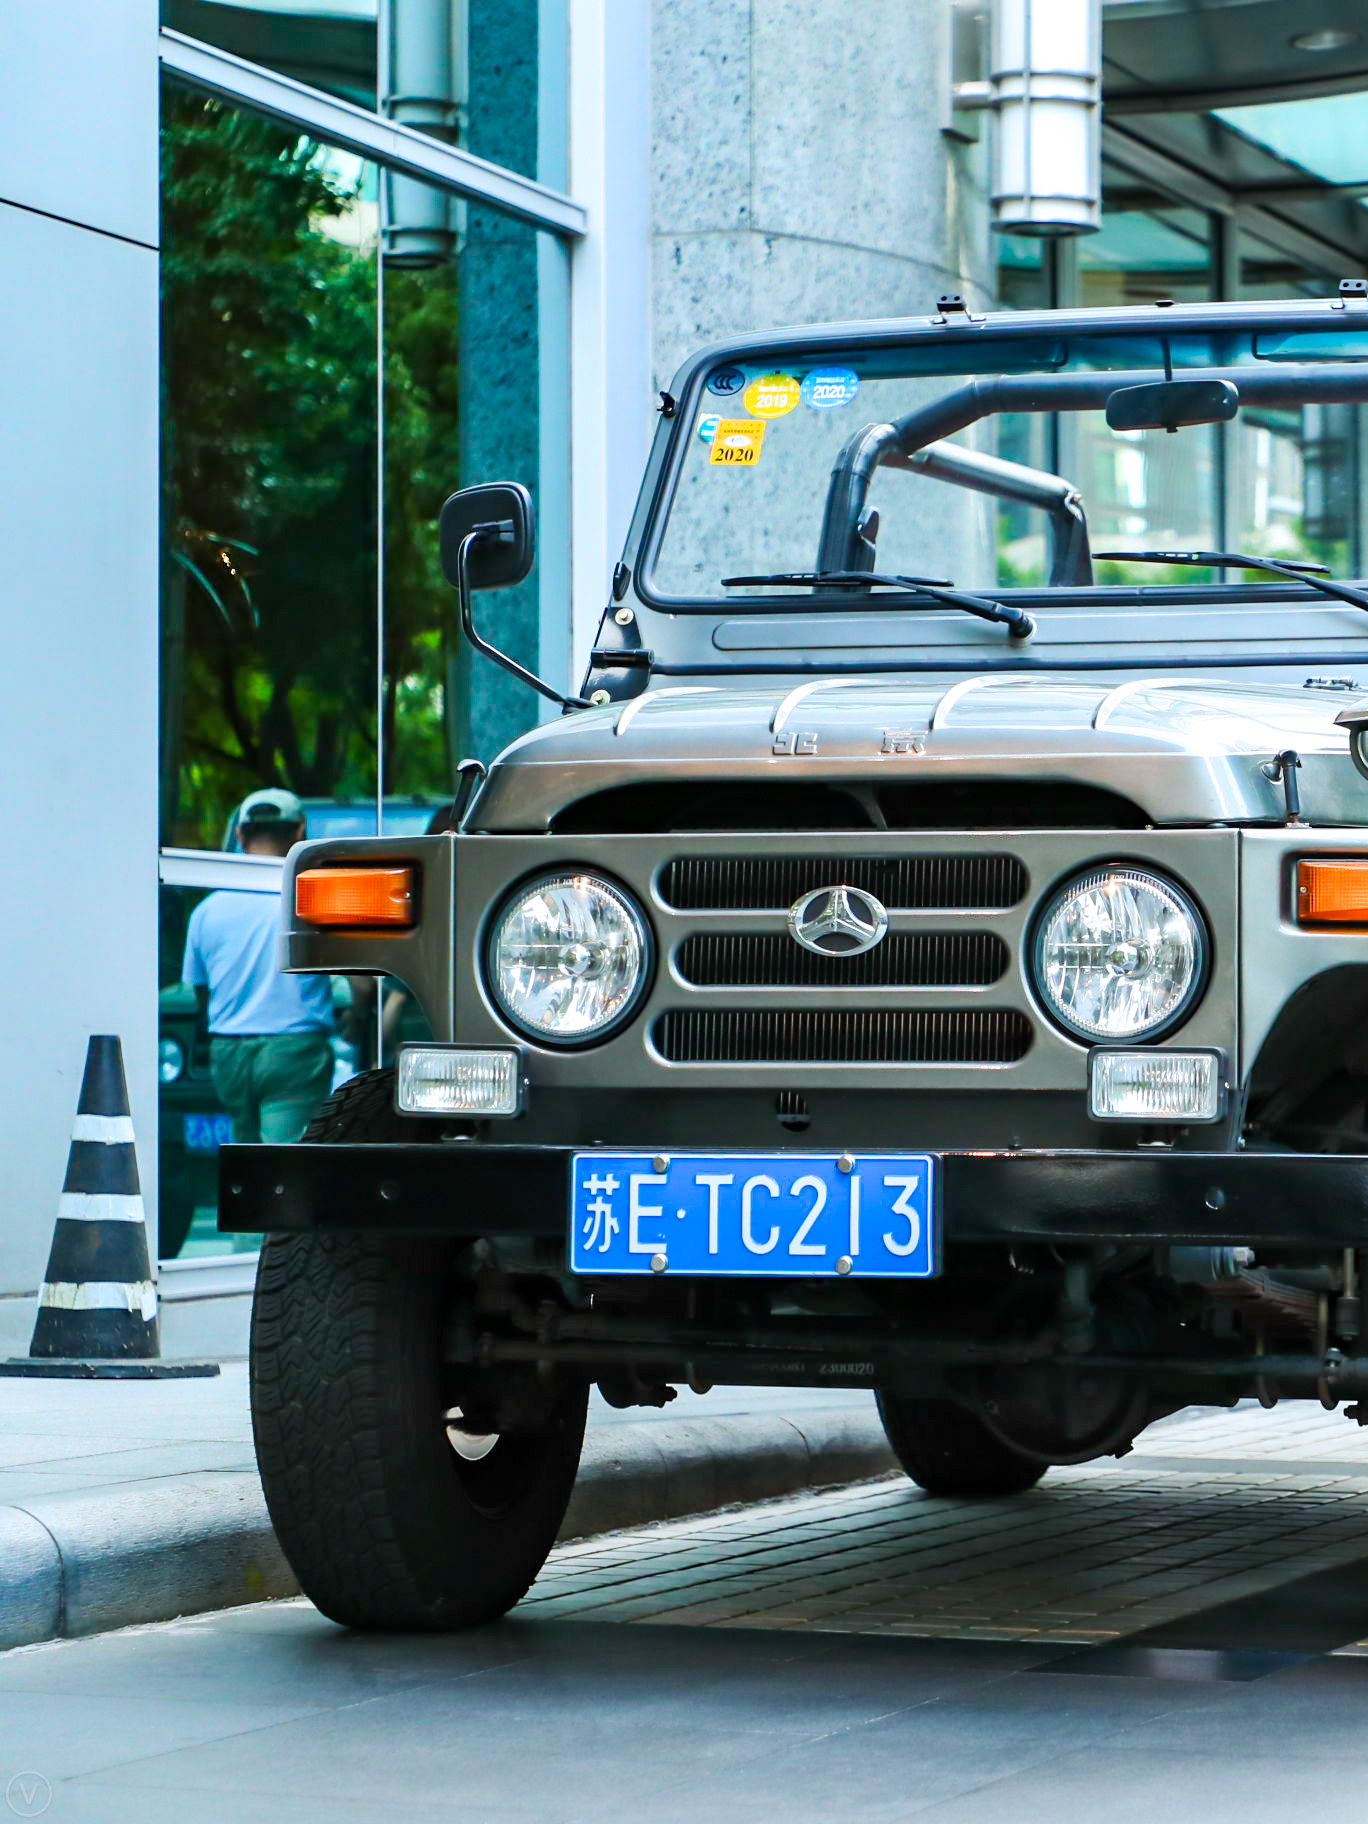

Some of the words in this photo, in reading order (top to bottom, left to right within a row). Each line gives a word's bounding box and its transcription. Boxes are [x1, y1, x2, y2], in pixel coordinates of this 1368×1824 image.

[812, 384, 846, 399] 2020
[755, 394, 788, 408] 2019
[714, 447, 754, 462] 2020
[582, 1173, 921, 1257] 苏E·TC213
